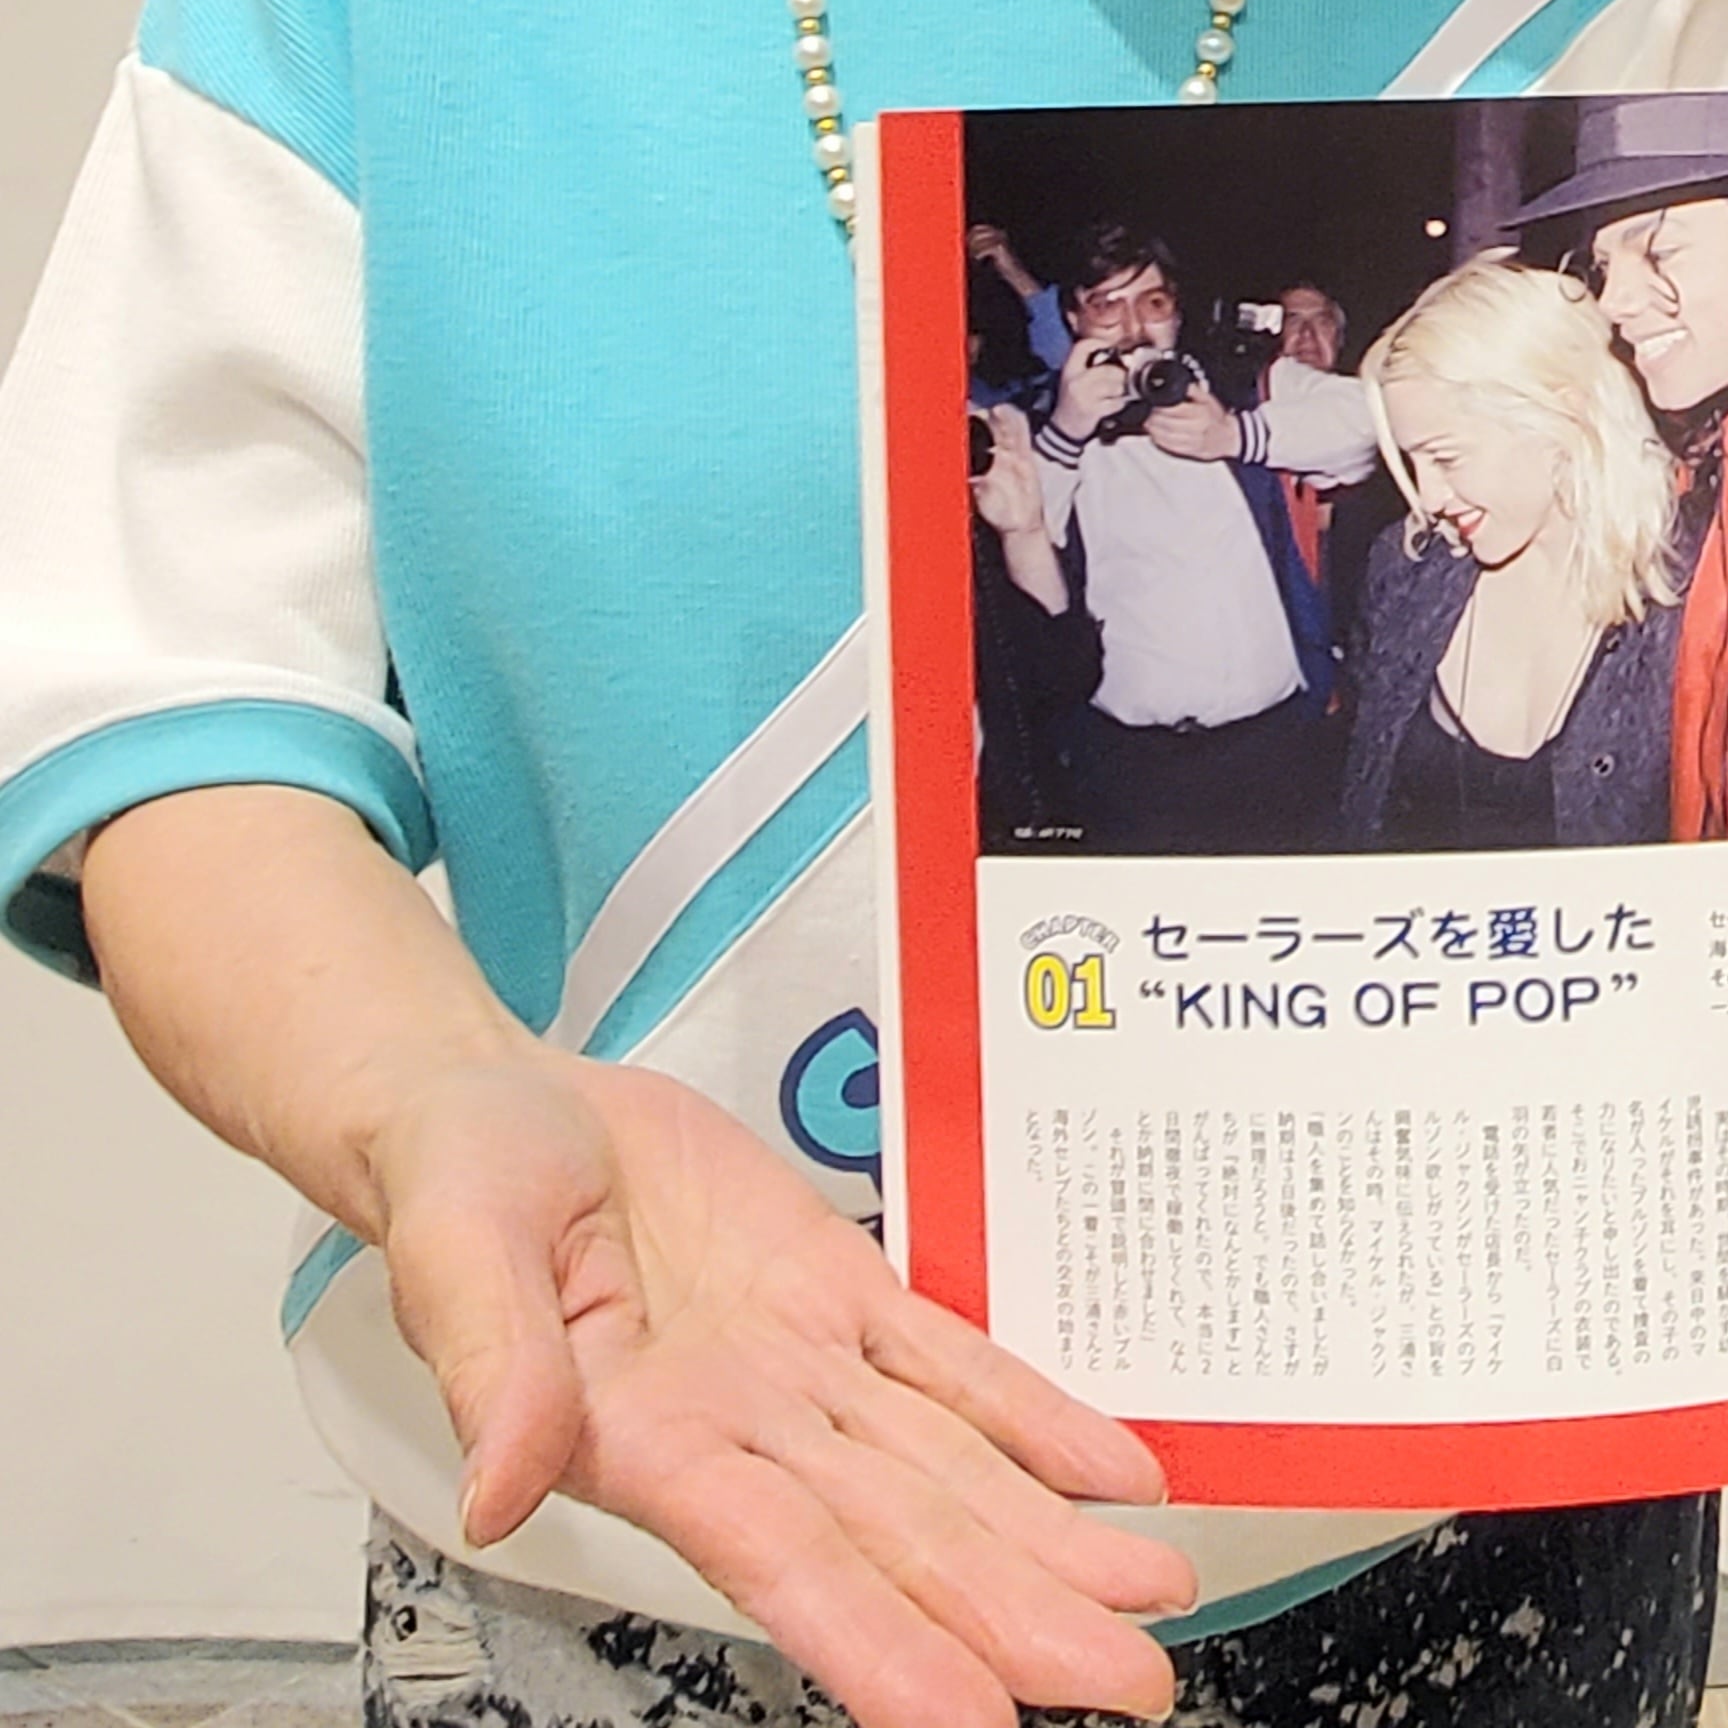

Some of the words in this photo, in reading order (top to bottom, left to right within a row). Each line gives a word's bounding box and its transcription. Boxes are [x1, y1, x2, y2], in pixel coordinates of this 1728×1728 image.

[1019, 914, 1121, 955] CHAPTER
[1142, 903, 1656, 962] セーラーズを愛した
[1025, 952, 1117, 1030] 01
[1354, 982, 1441, 1028] OF
